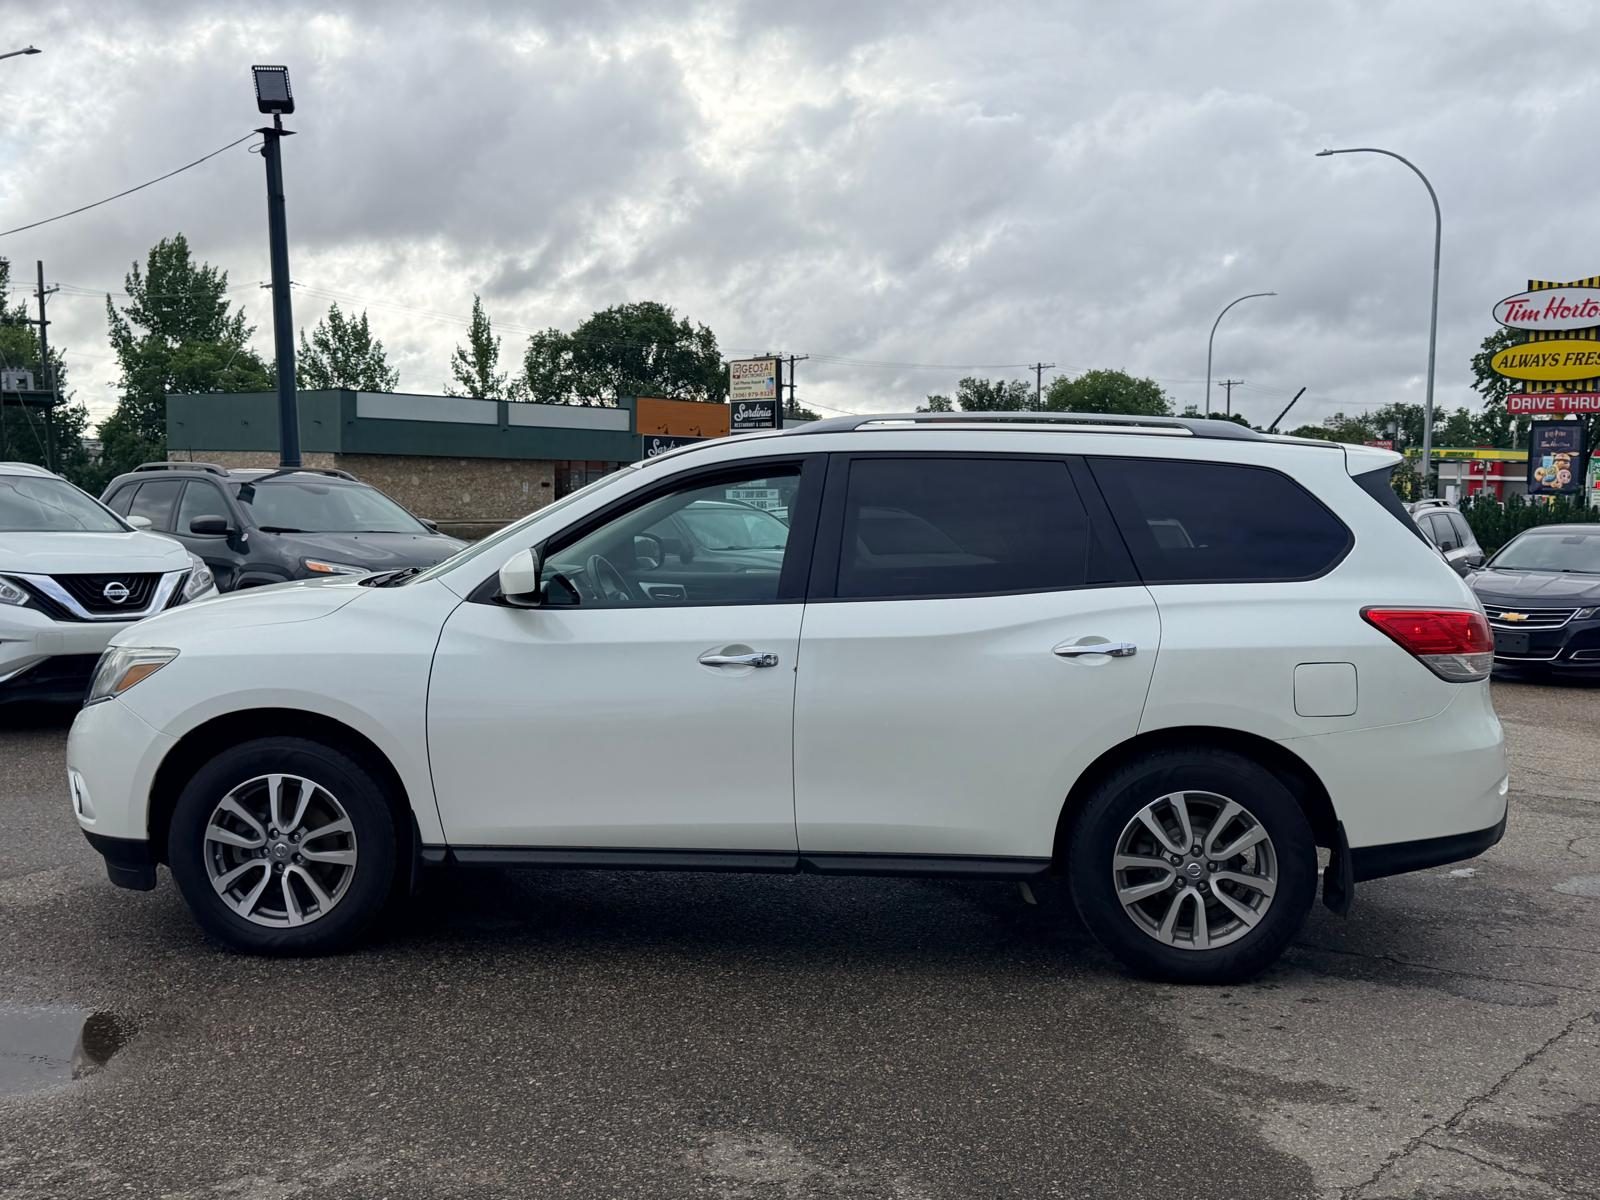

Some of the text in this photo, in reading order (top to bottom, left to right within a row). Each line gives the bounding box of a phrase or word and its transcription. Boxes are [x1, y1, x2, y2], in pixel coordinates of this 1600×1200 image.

[1504, 296, 1600, 323] Tim Horto
[741, 363, 774, 374] GEOSAT
[1498, 353, 1561, 369] ALWAYS
[1511, 397, 1600, 410] DRIVE THRU
[734, 403, 772, 421] Sardinia
